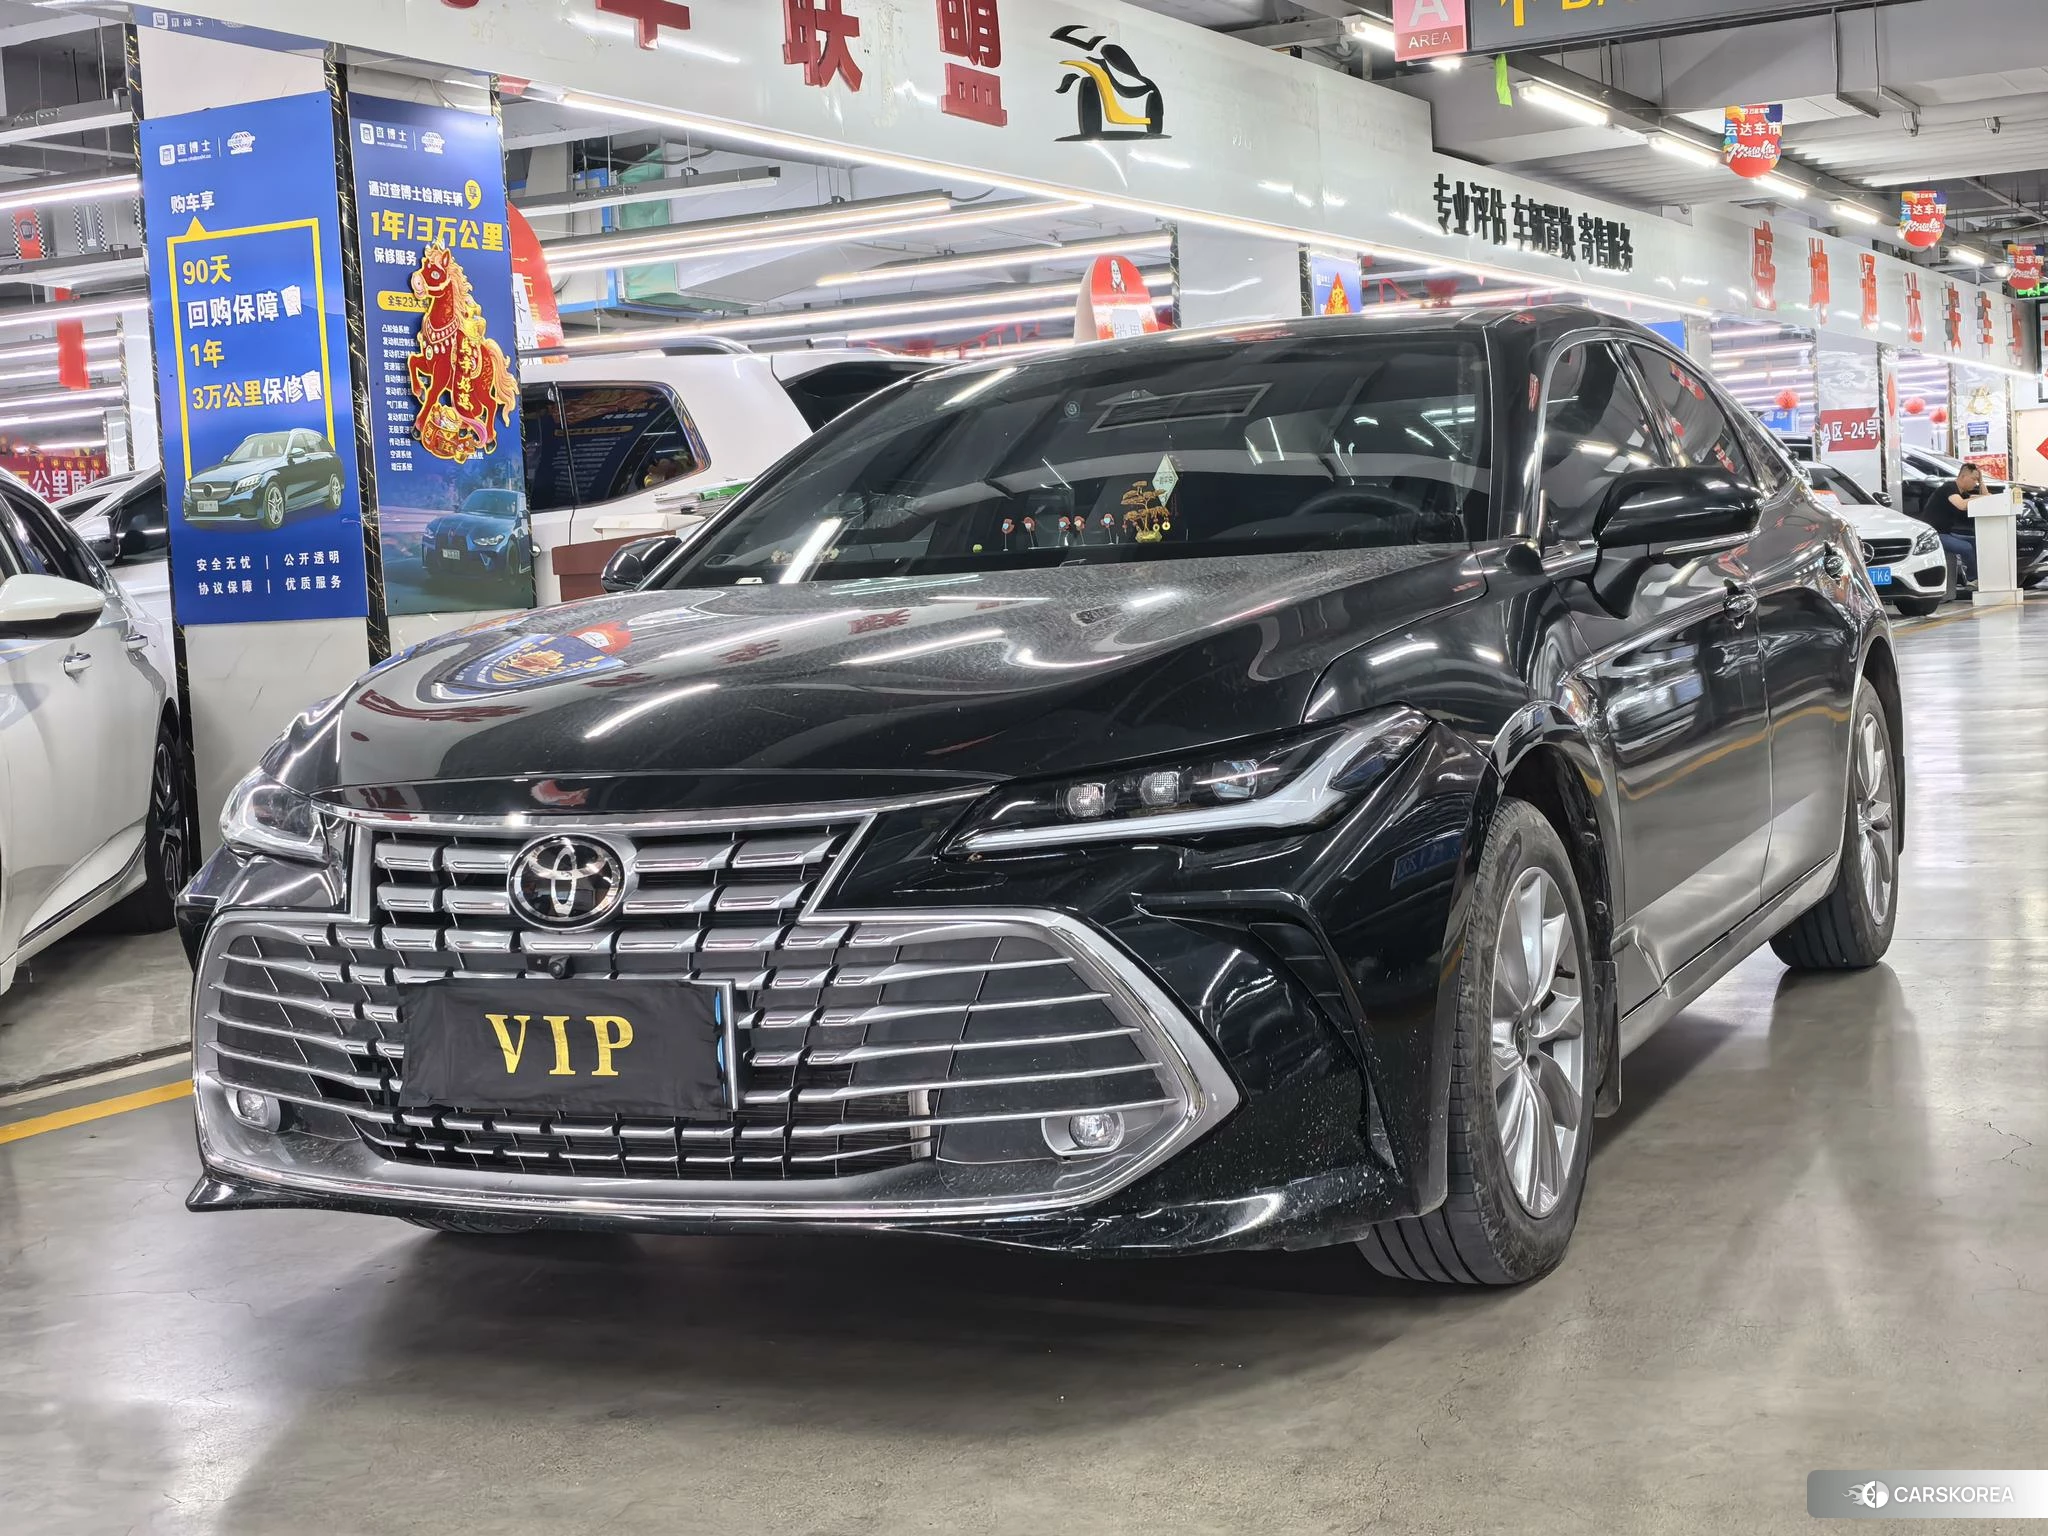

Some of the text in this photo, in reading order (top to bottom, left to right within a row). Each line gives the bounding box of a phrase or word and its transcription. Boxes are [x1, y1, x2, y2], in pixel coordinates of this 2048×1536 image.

[1408, 0, 1449, 27] A
[1408, 31, 1451, 49] AREA
[1725, 121, 1781, 137] 云达车市
[170, 190, 216, 214] 购车享
[368, 180, 464, 207] 通过查博士检测车辆
[1433, 173, 1634, 272] 专业评估 车辆置换 寄售服务
[1901, 204, 1946, 215] 云达车市
[370, 209, 504, 252] 1年/3万公里
[182, 254, 232, 285] 90天
[373, 247, 417, 266] 保修服务
[187, 290, 280, 330] 回购保障
[190, 338, 226, 369] 1年
[382, 336, 418, 347] 发动机控制系
[192, 373, 303, 410] 3万公里保修
[1820, 416, 1880, 441] A区-24号
[196, 550, 340, 572] 安全无忧 公开透明
[198, 575, 342, 596] 协议保障 优质服务
[485, 1013, 634, 1076] VIP
